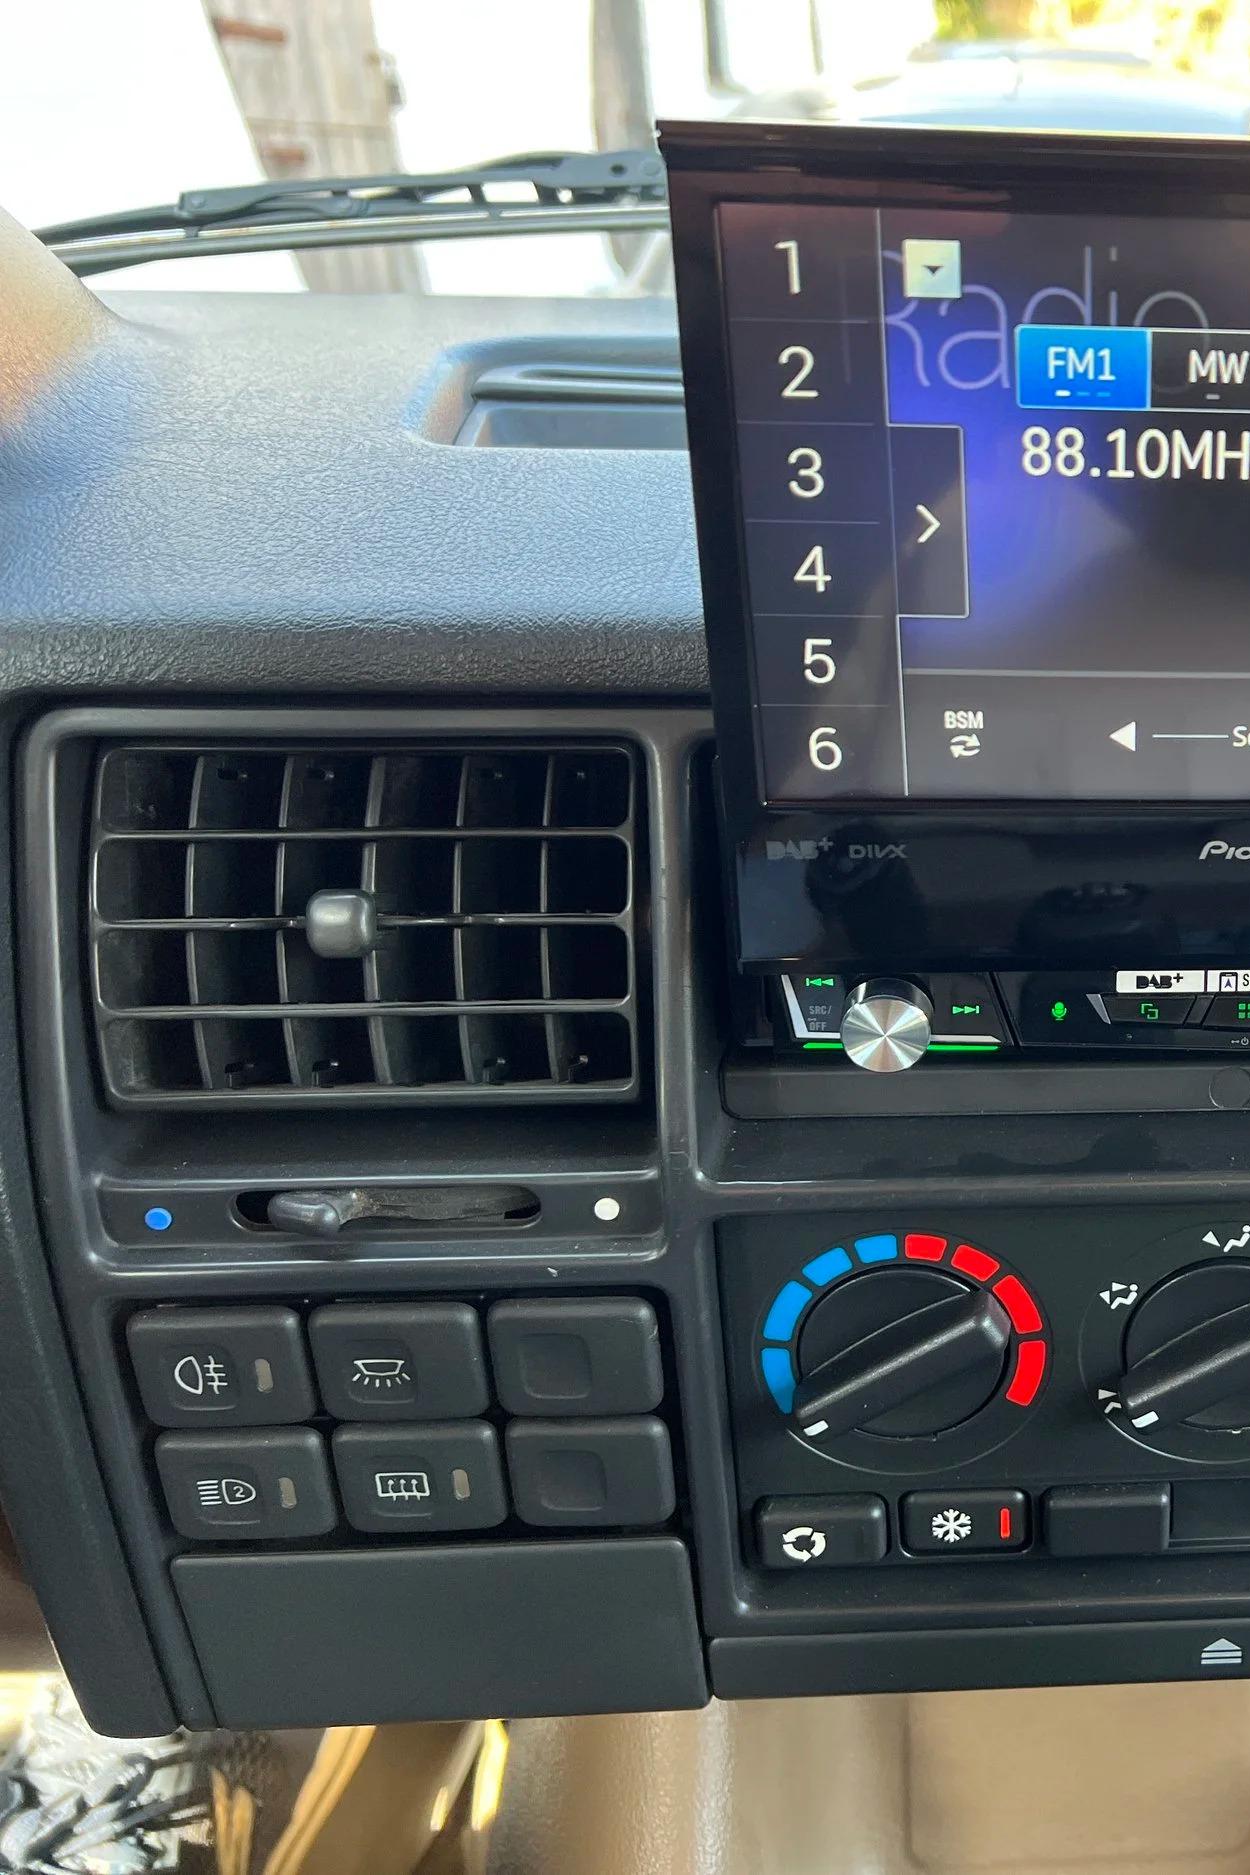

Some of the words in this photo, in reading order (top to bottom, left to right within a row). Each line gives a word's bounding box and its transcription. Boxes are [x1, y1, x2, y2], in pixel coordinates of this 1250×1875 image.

[774, 240, 801, 295] 1
[778, 345, 819, 398] 2
[1046, 346, 1116, 381] FM1
[1187, 349, 1250, 384] MW
[787, 447, 825, 498] 3
[793, 545, 832, 593] 4
[803, 638, 836, 684] 5
[943, 710, 984, 730] BSM
[808, 726, 843, 771] 6
[809, 1022, 827, 1031] OFF
